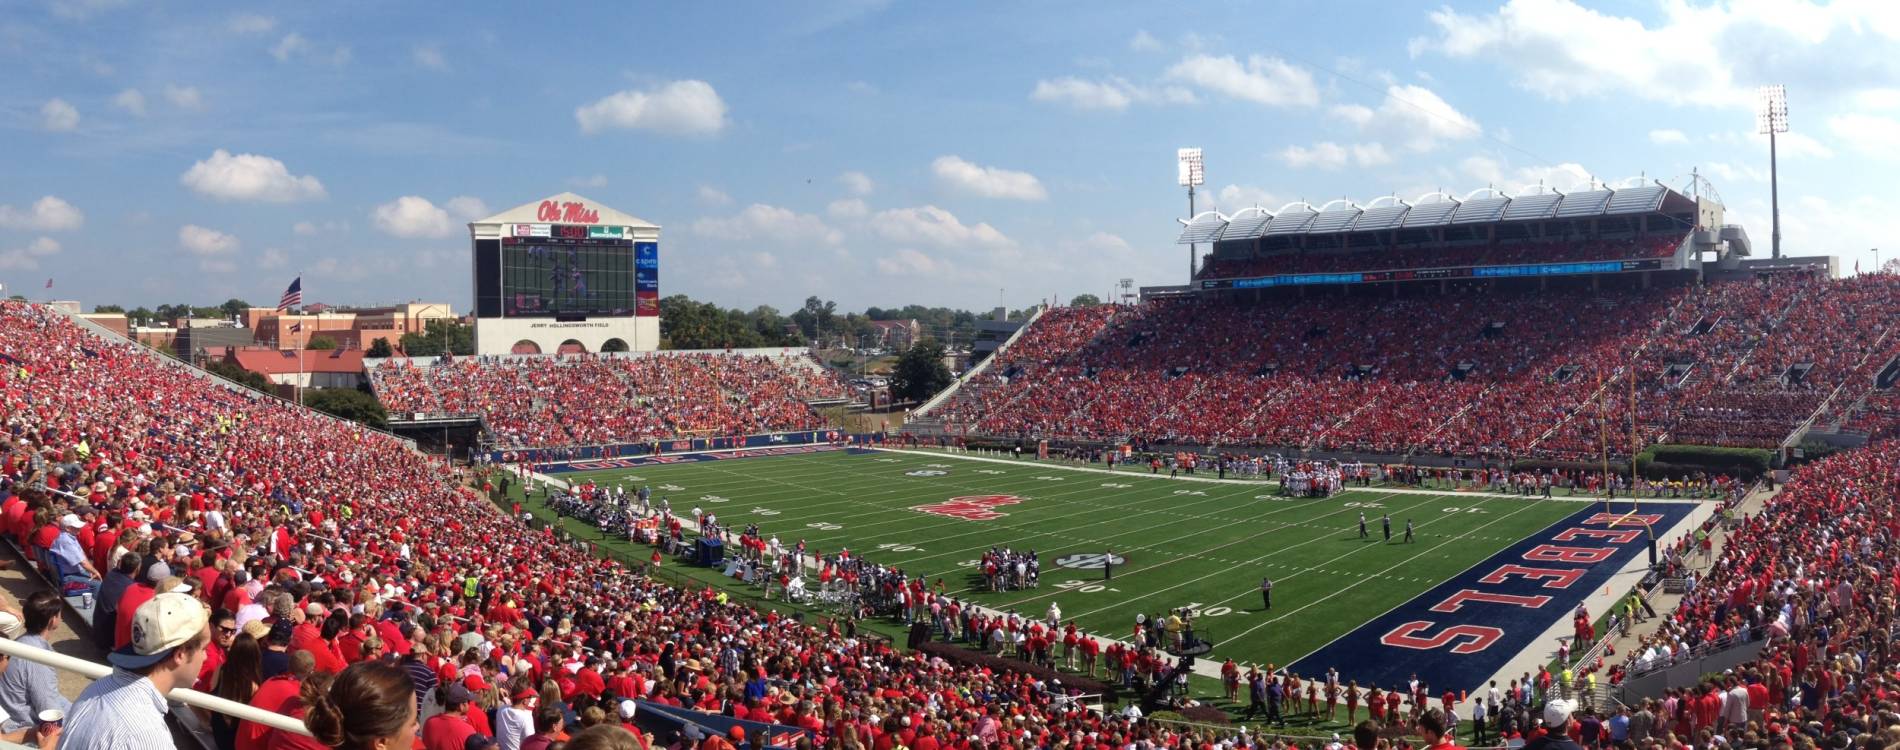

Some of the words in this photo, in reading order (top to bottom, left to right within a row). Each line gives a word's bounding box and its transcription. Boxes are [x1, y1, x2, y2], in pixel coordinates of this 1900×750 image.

[537, 200, 561, 222] Ole
[562, 201, 599, 224] Miss
[1052, 579, 1107, 593] 20
[1380, 513, 1665, 655] REBELS
